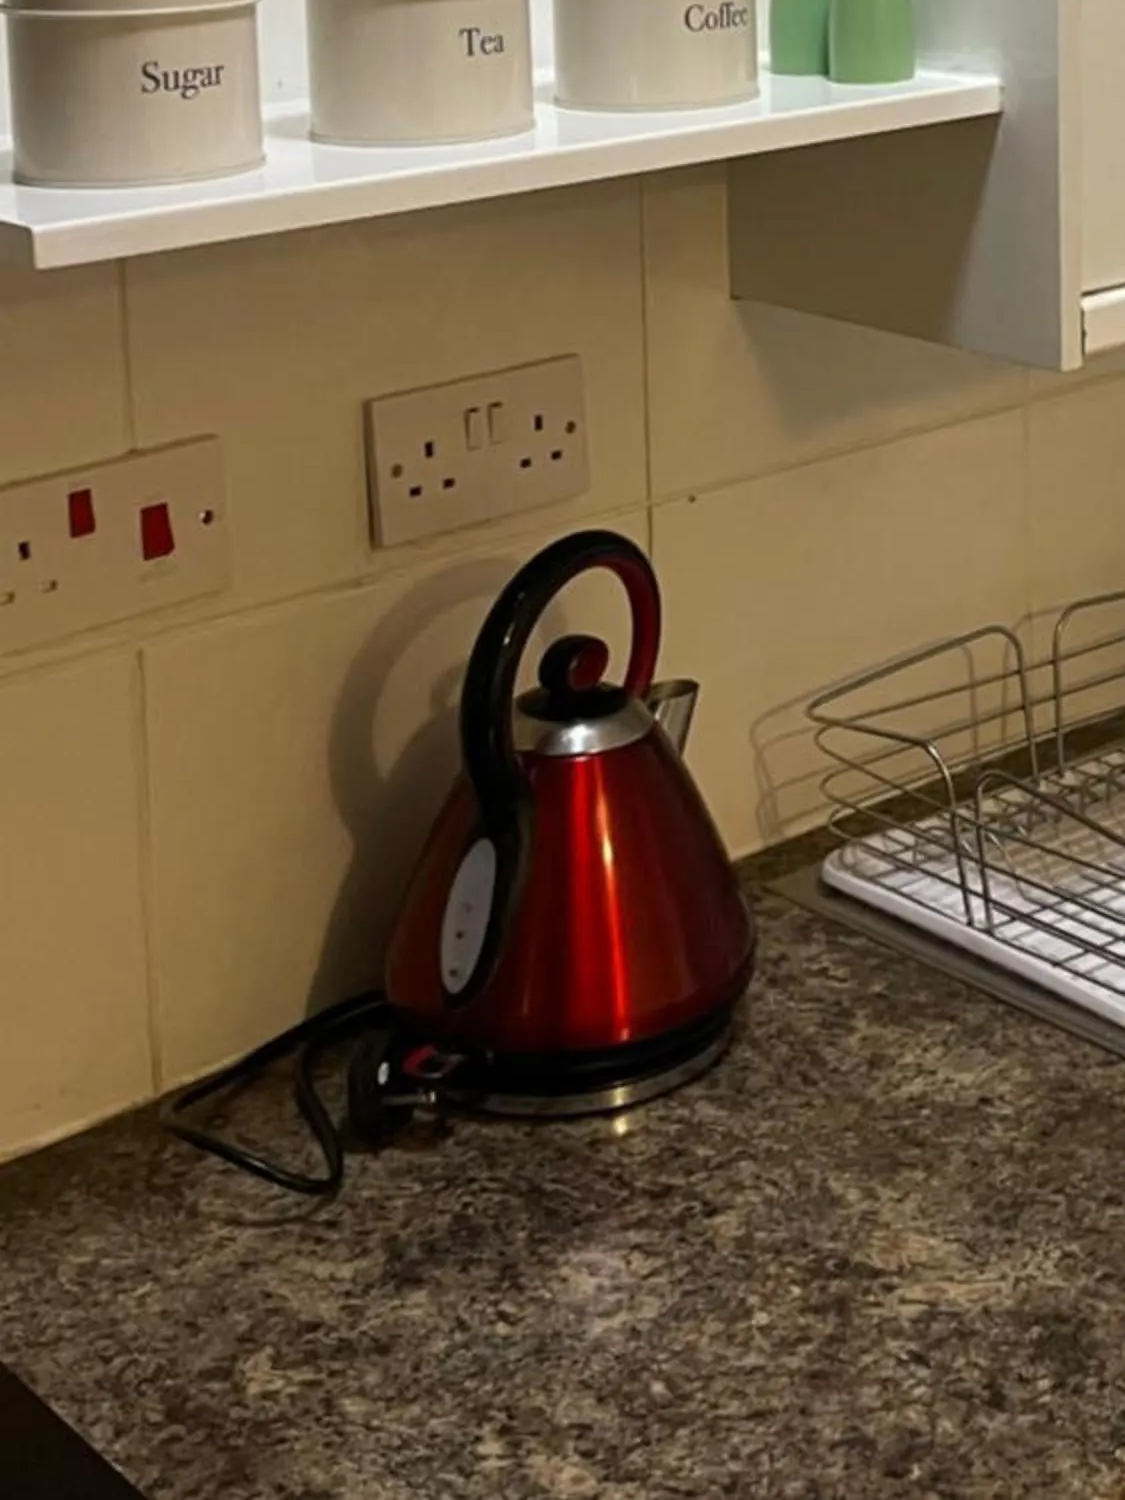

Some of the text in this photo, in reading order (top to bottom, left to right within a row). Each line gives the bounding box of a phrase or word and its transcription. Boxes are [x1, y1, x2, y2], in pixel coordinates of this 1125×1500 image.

[683, 1, 748, 32] Coffee
[458, 26, 505, 57] Tea
[141, 60, 225, 100] Sugar
